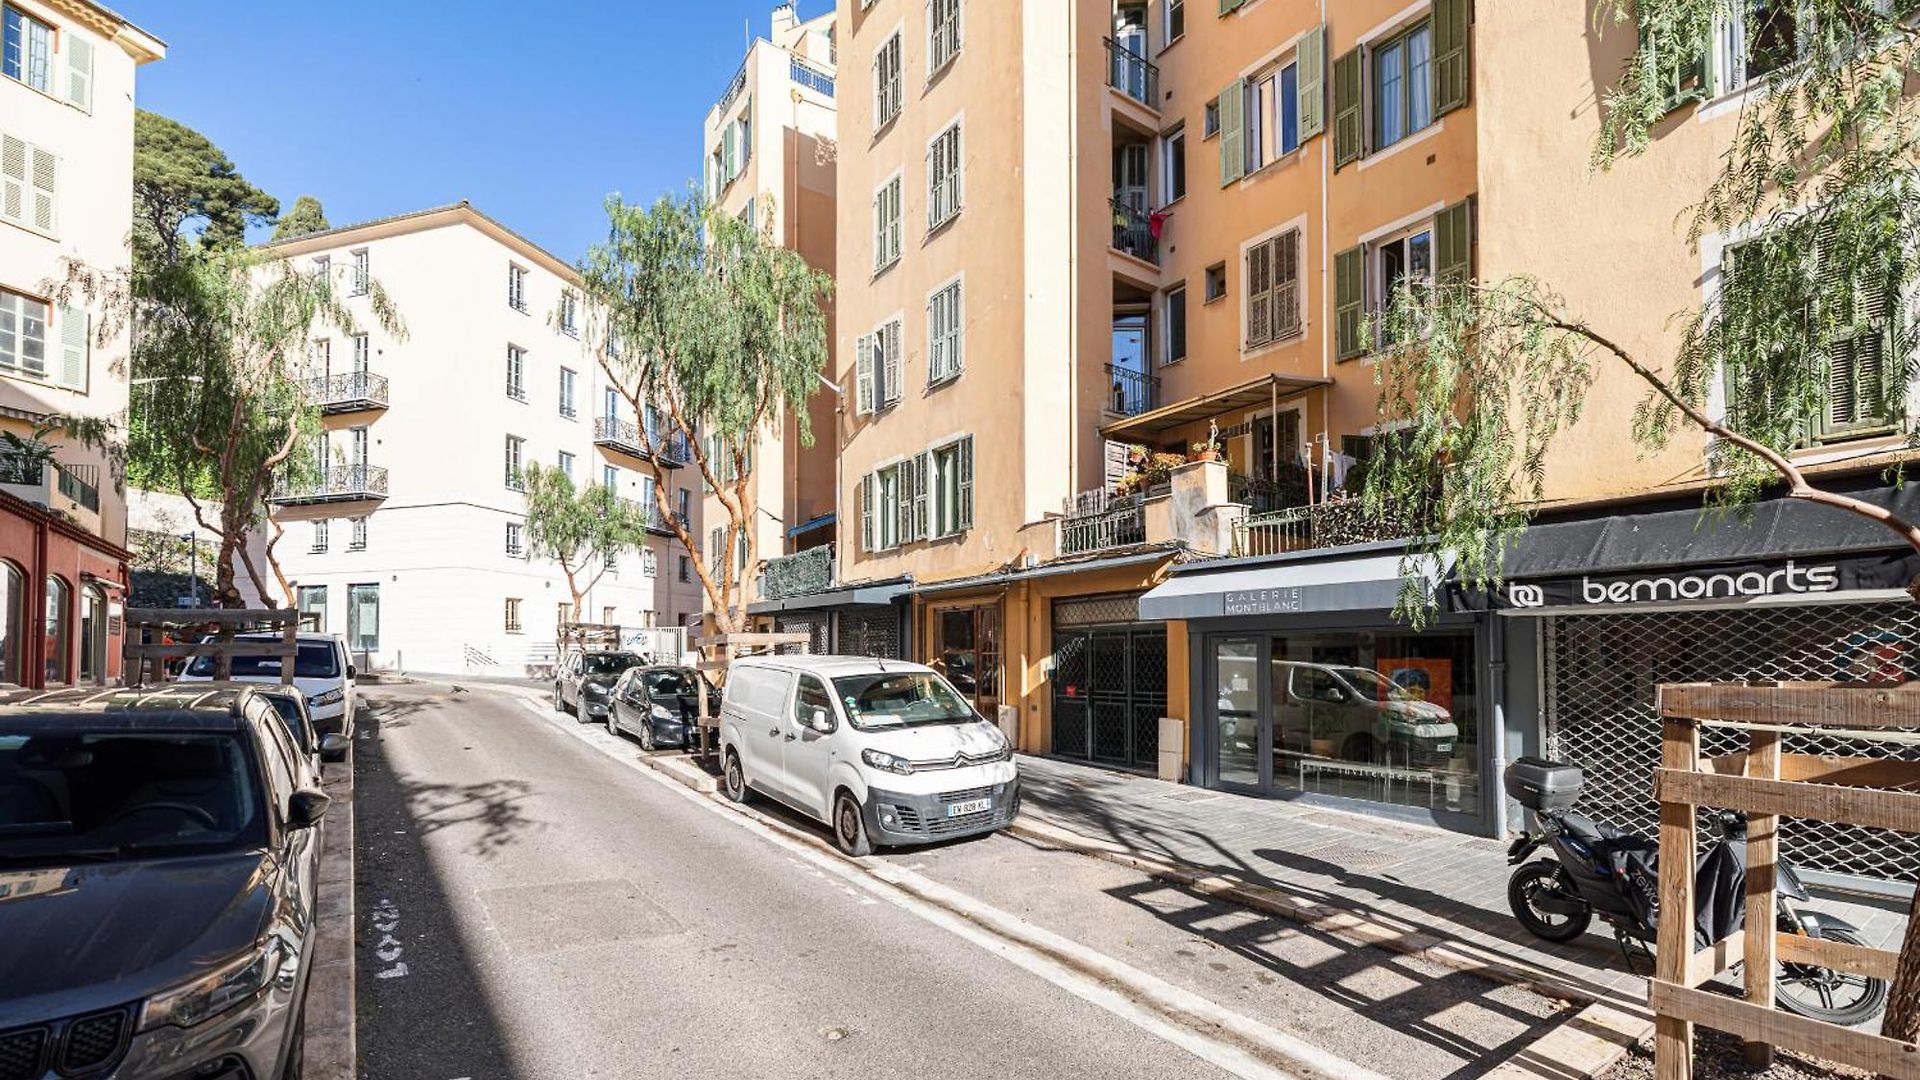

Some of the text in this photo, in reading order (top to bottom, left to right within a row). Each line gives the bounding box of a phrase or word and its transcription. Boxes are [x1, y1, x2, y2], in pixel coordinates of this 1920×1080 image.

[1582, 560, 1838, 604] bemonarts
[1226, 588, 1299, 602] GALERIE
[1226, 601, 1299, 614] MONTBLANC
